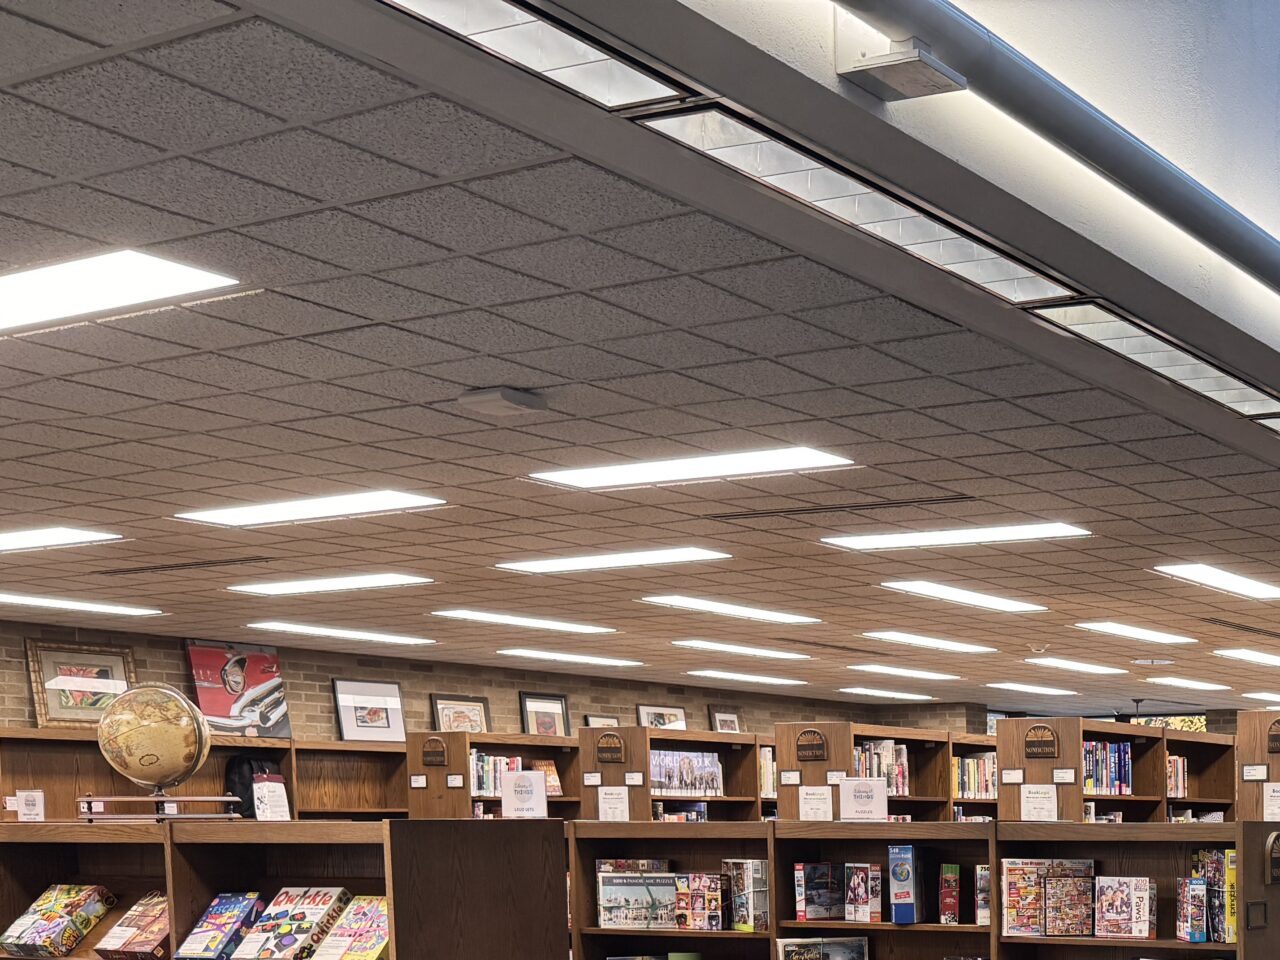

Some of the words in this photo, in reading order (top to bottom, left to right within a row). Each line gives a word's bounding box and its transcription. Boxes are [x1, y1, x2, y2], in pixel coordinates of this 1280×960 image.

[651, 754, 680, 767] WORLD
[1136, 896, 1144, 920] Paws
[311, 905, 343, 944] Qwirkle
